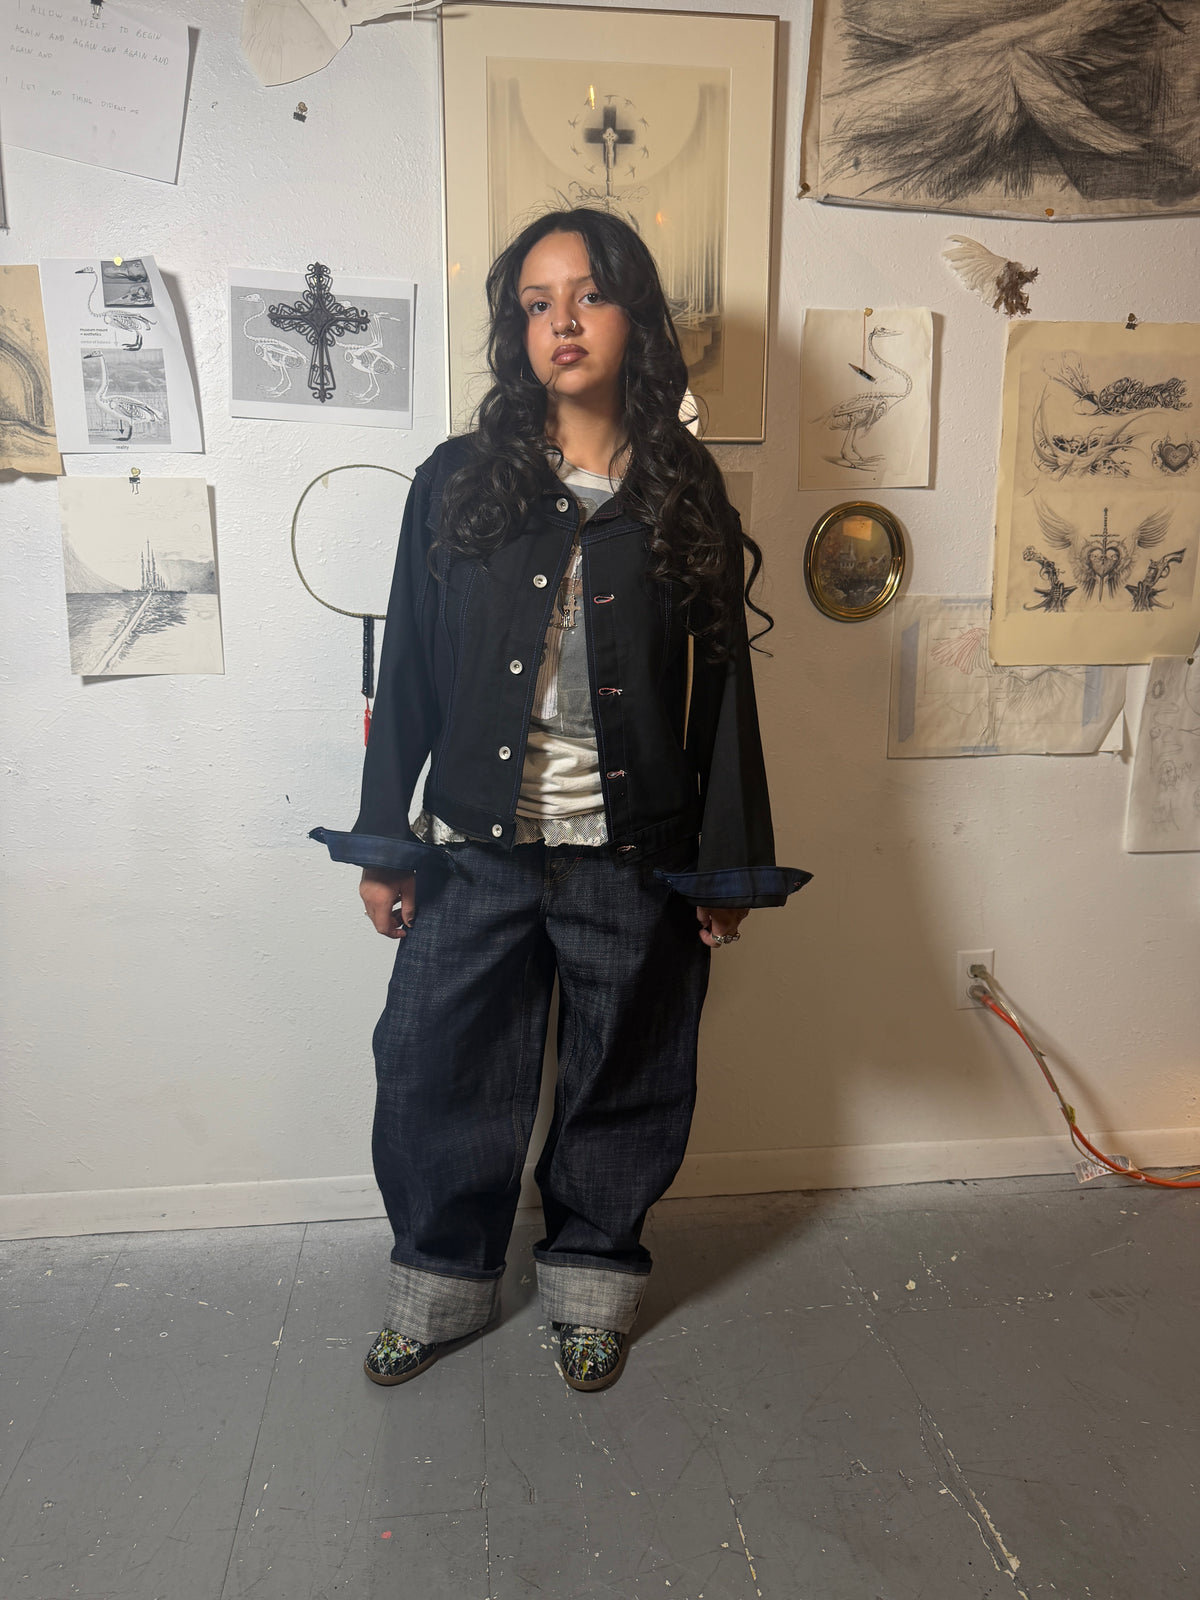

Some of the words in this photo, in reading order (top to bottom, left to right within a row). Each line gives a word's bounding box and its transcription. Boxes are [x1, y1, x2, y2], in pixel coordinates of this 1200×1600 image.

[30, 4, 63, 19] ALLOW
[71, 15, 108, 31] MYSELF
[120, 26, 129, 34] TO
[135, 28, 162, 41] BEGIN
[10, 44, 33, 55] AGAIN
[15, 23, 41, 38] AGAIN
[49, 32, 65, 42] AND
[72, 37, 98, 50] AGAIN
[123, 47, 147, 60] AGAIN
[152, 55, 169, 66] AND
